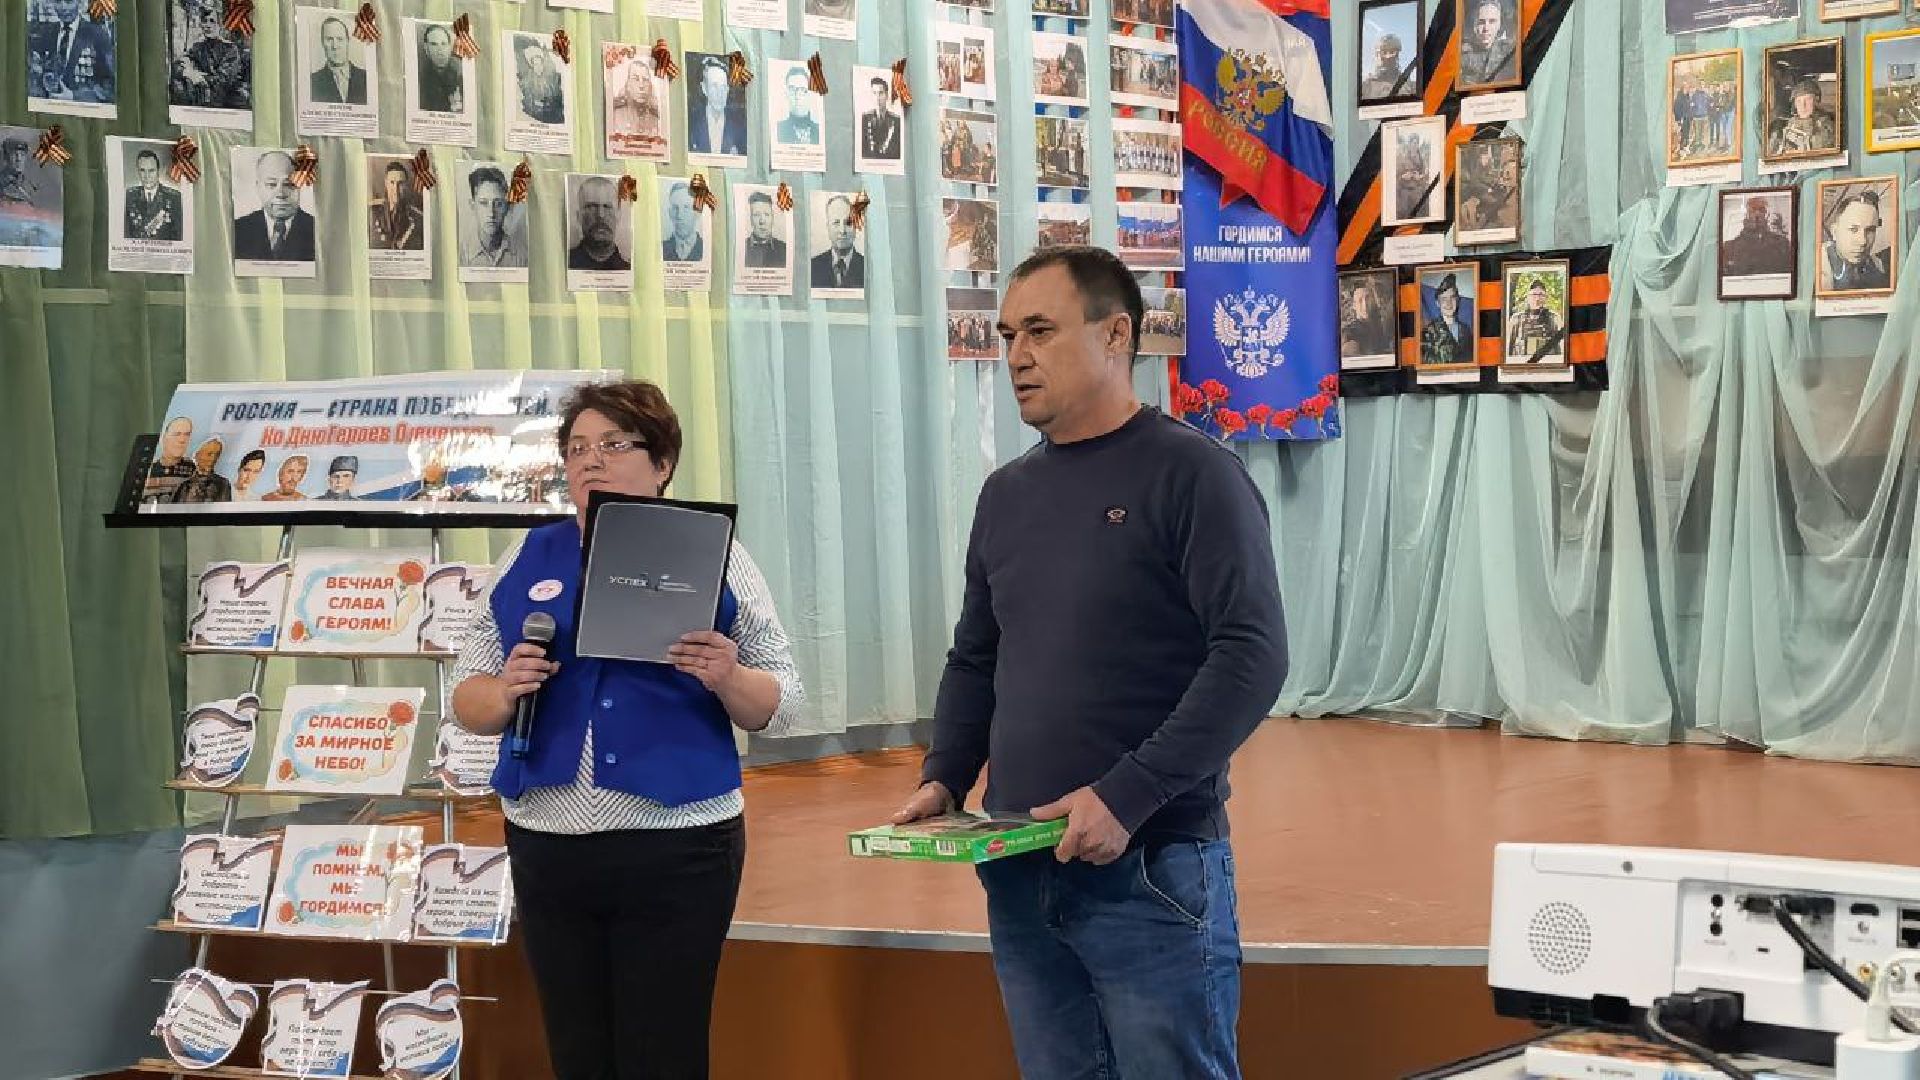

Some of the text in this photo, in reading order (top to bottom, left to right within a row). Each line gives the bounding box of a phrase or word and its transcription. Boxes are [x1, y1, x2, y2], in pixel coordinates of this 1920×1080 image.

[1186, 100, 1268, 172] РОССИЯ
[1218, 225, 1283, 244] ГОРДИМСЯ
[1193, 246, 1312, 263] НАШИМИ ГЕРОЯМИ!
[221, 401, 298, 421] РОССИЯ
[326, 576, 394, 590] ВЕЧНАЯ
[328, 596, 385, 610] СЛАВА
[315, 615, 392, 631] ГЕРОЯМ!
[308, 715, 388, 730] СПАСИБО
[294, 735, 394, 751] ЗА МИРНОЕ
[314, 755, 367, 771] НЕБО!
[336, 843, 364, 857] МЫ
